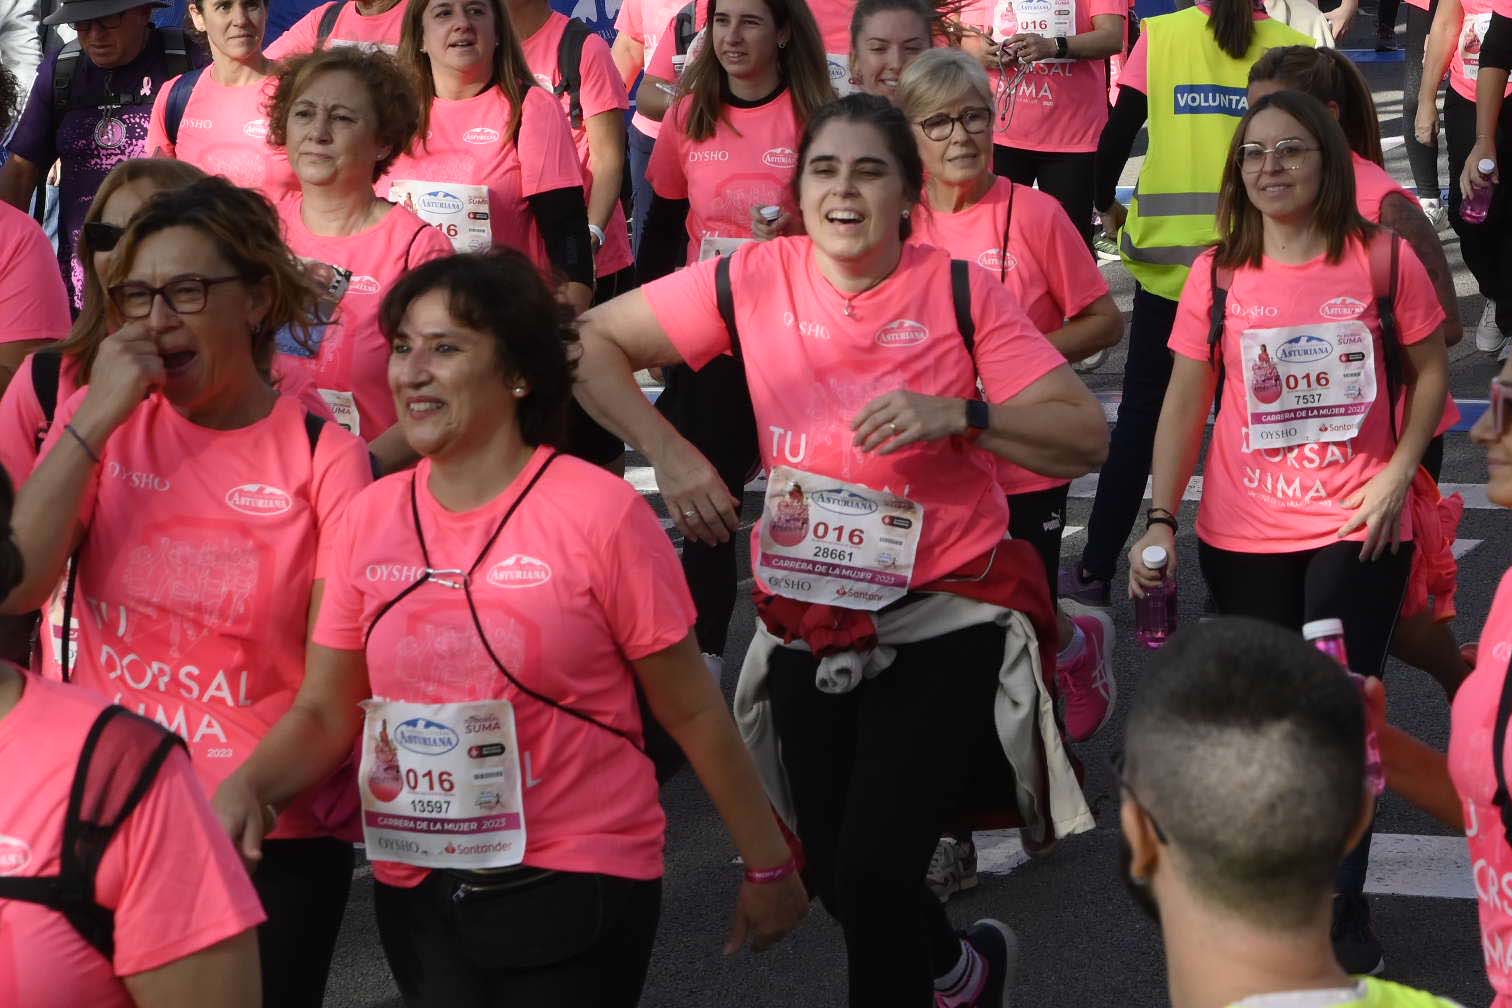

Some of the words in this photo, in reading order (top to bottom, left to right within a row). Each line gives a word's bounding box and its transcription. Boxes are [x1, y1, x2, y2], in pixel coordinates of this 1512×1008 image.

[1021, 20, 1048, 30] 016
[1176, 93, 1249, 110] VOLUNTA
[689, 150, 729, 162] OYSHO
[421, 197, 463, 212] ASTURIANA
[435, 224, 458, 238] 16
[783, 311, 832, 340] OSHO
[1279, 346, 1329, 359] ASTURIANA
[1285, 371, 1330, 391] 016
[1294, 393, 1323, 405] 7537
[1261, 412, 1294, 422] CARRERA
[1296, 410, 1306, 419] DE
[1308, 409, 1317, 417] LA
[1319, 407, 1345, 416] MUJER
[1260, 428, 1298, 440] OYSHO
[768, 425, 808, 464] TU
[230, 491, 288, 510] ASTURIANA
[816, 492, 873, 512] ASTURIANA
[813, 521, 865, 545] 016
[813, 545, 854, 563] 28661
[771, 557, 813, 571] CARRERA
[814, 564, 827, 573] DE
[828, 566, 841, 576] LA
[841, 569, 873, 580] MUJER
[464, 722, 501, 734] SUMA
[400, 730, 453, 748] ASTURIANA
[207, 748, 232, 758] 2023
[406, 768, 455, 792] 016
[410, 800, 451, 814] 13597
[377, 816, 416, 829] CARRERA
[416, 821, 428, 830] DE
[429, 822, 442, 830] LA
[444, 822, 479, 831] MUJER
[378, 837, 419, 853] OYSHO
[457, 842, 513, 855] Santander
